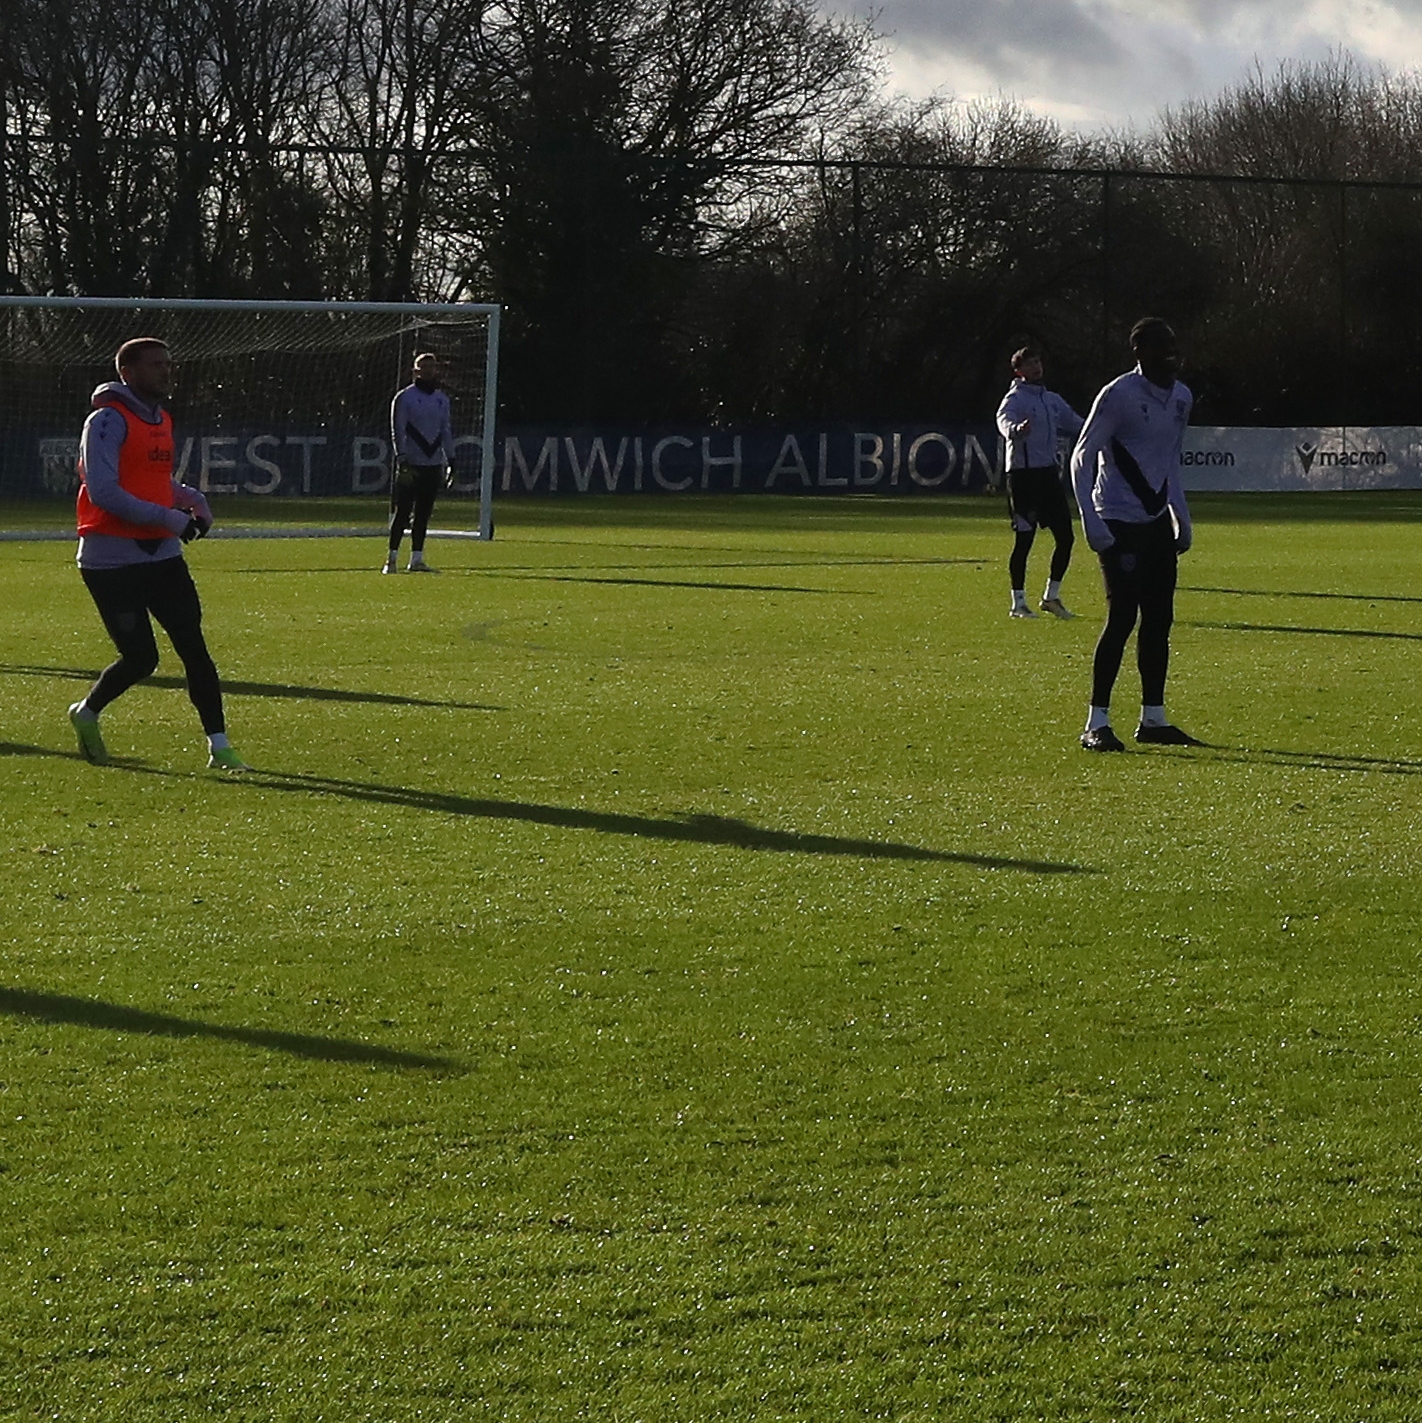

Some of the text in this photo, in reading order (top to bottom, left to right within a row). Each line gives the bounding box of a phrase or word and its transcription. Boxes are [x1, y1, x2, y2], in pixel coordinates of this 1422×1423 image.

[175, 432, 1001, 495] EST BOMWICH ALBION
[1320, 450, 1386, 466] macron
